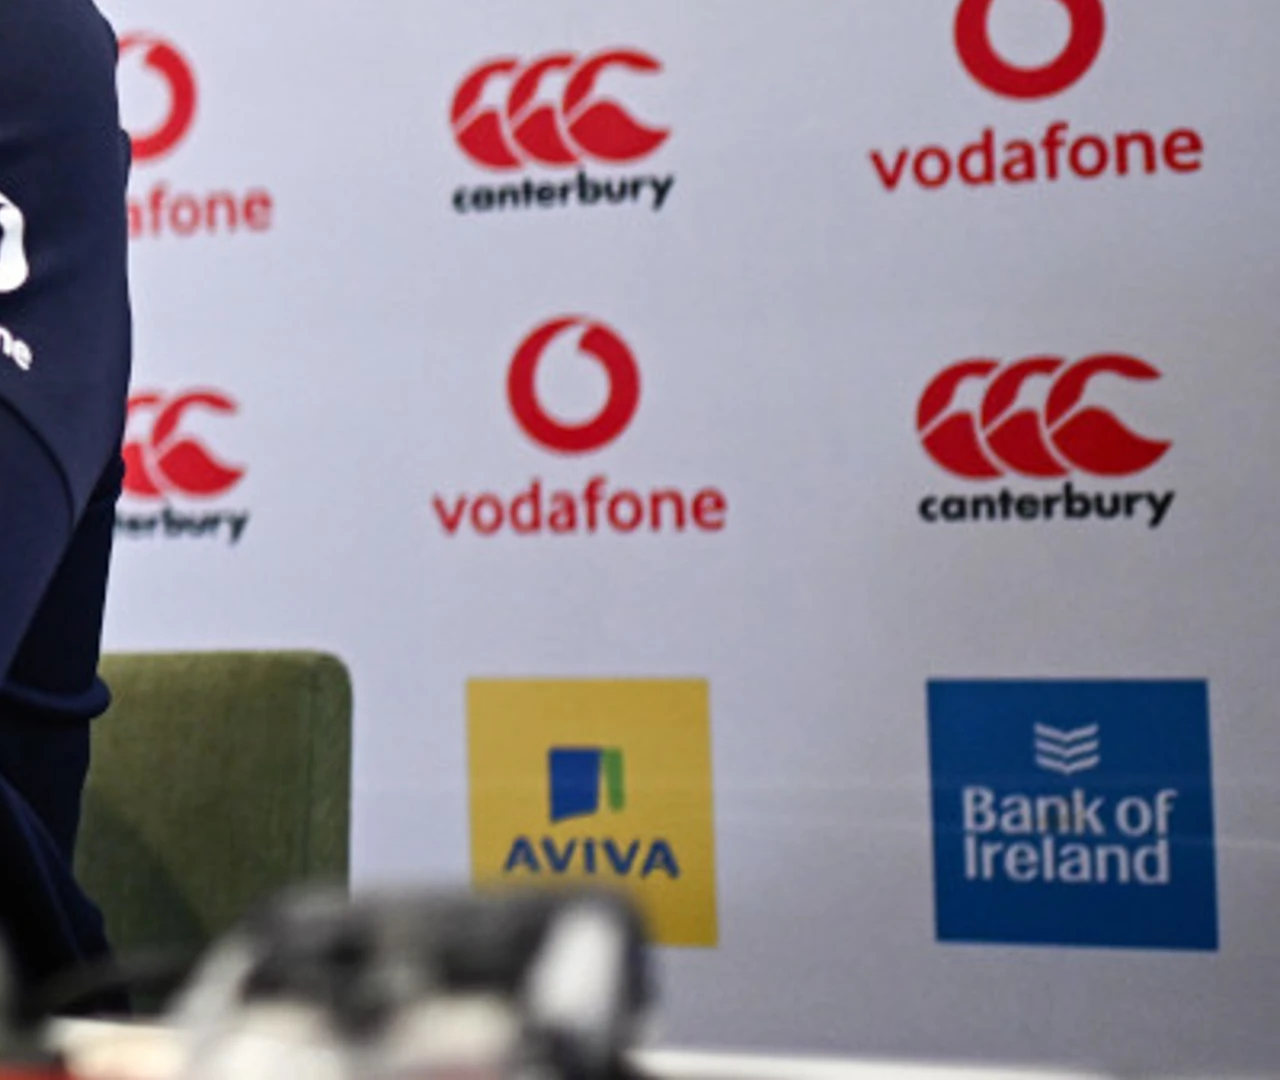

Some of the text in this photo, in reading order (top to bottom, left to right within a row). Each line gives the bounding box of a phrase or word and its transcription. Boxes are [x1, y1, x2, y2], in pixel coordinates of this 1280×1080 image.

[870, 122, 1204, 191] vodafone
[127, 178, 274, 239] fone
[452, 169, 675, 214] canterbury
[115, 501, 251, 548] terbury
[432, 476, 727, 535] vodafone
[918, 481, 1176, 528] canterbury
[963, 787, 1177, 837] Bank of
[502, 834, 683, 880] AVIVA
[963, 836, 1171, 885] Ireland
